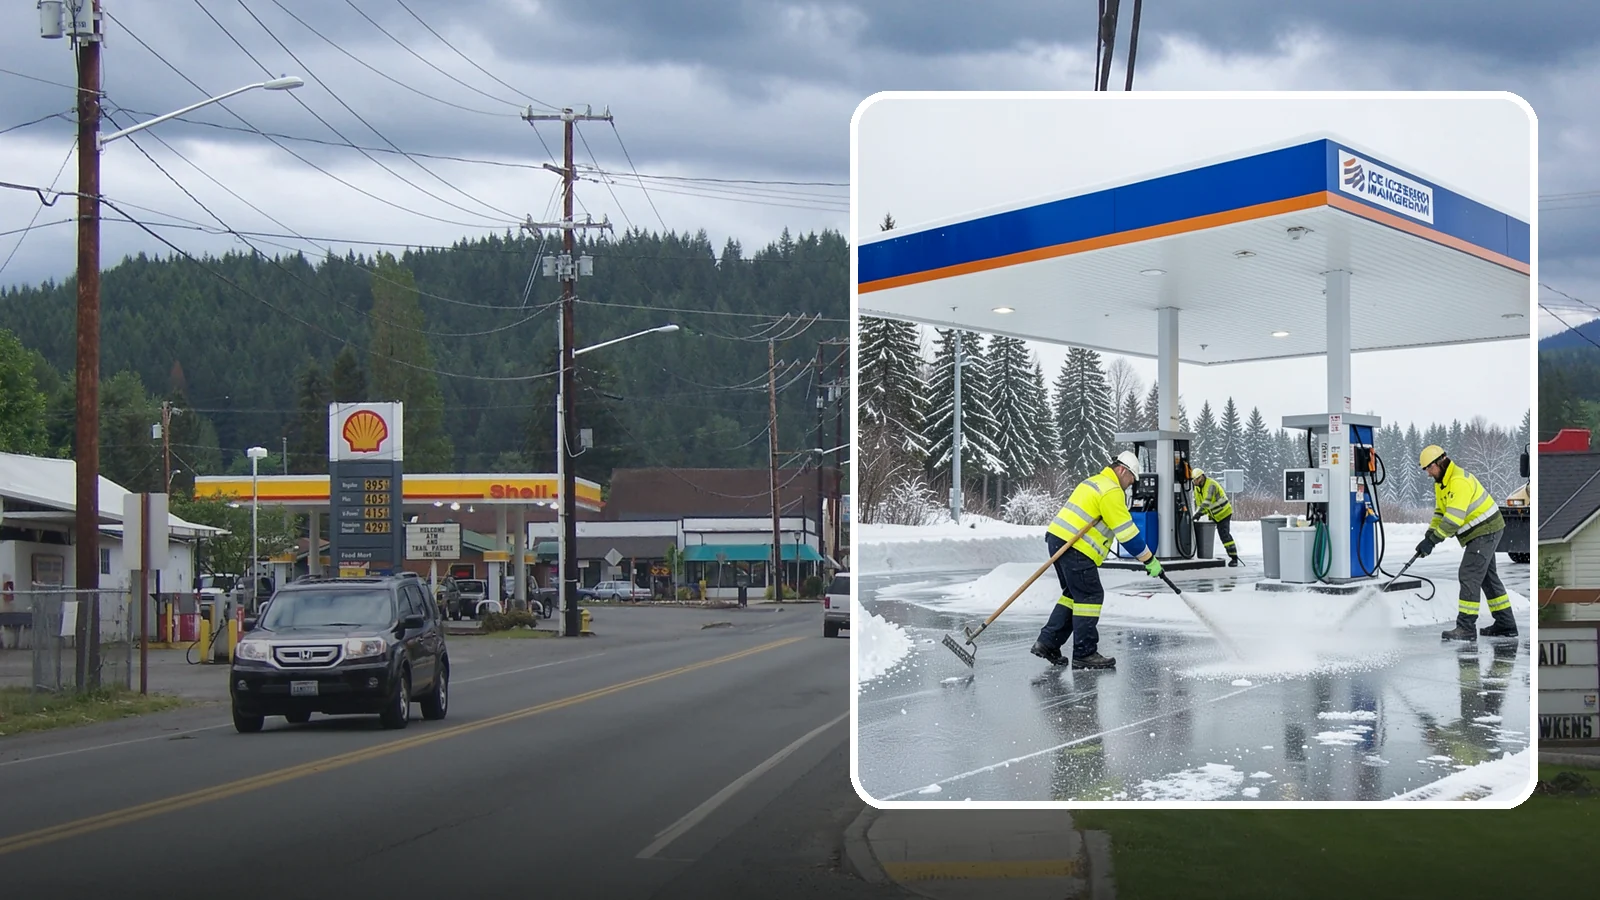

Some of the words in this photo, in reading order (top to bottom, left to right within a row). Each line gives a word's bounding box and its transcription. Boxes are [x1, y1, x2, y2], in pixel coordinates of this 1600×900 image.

[366, 480, 383, 490] 395
[490, 484, 547, 499] Shell
[366, 494, 383, 504] 405
[366, 508, 383, 518] 415
[366, 522, 383, 532] 429
